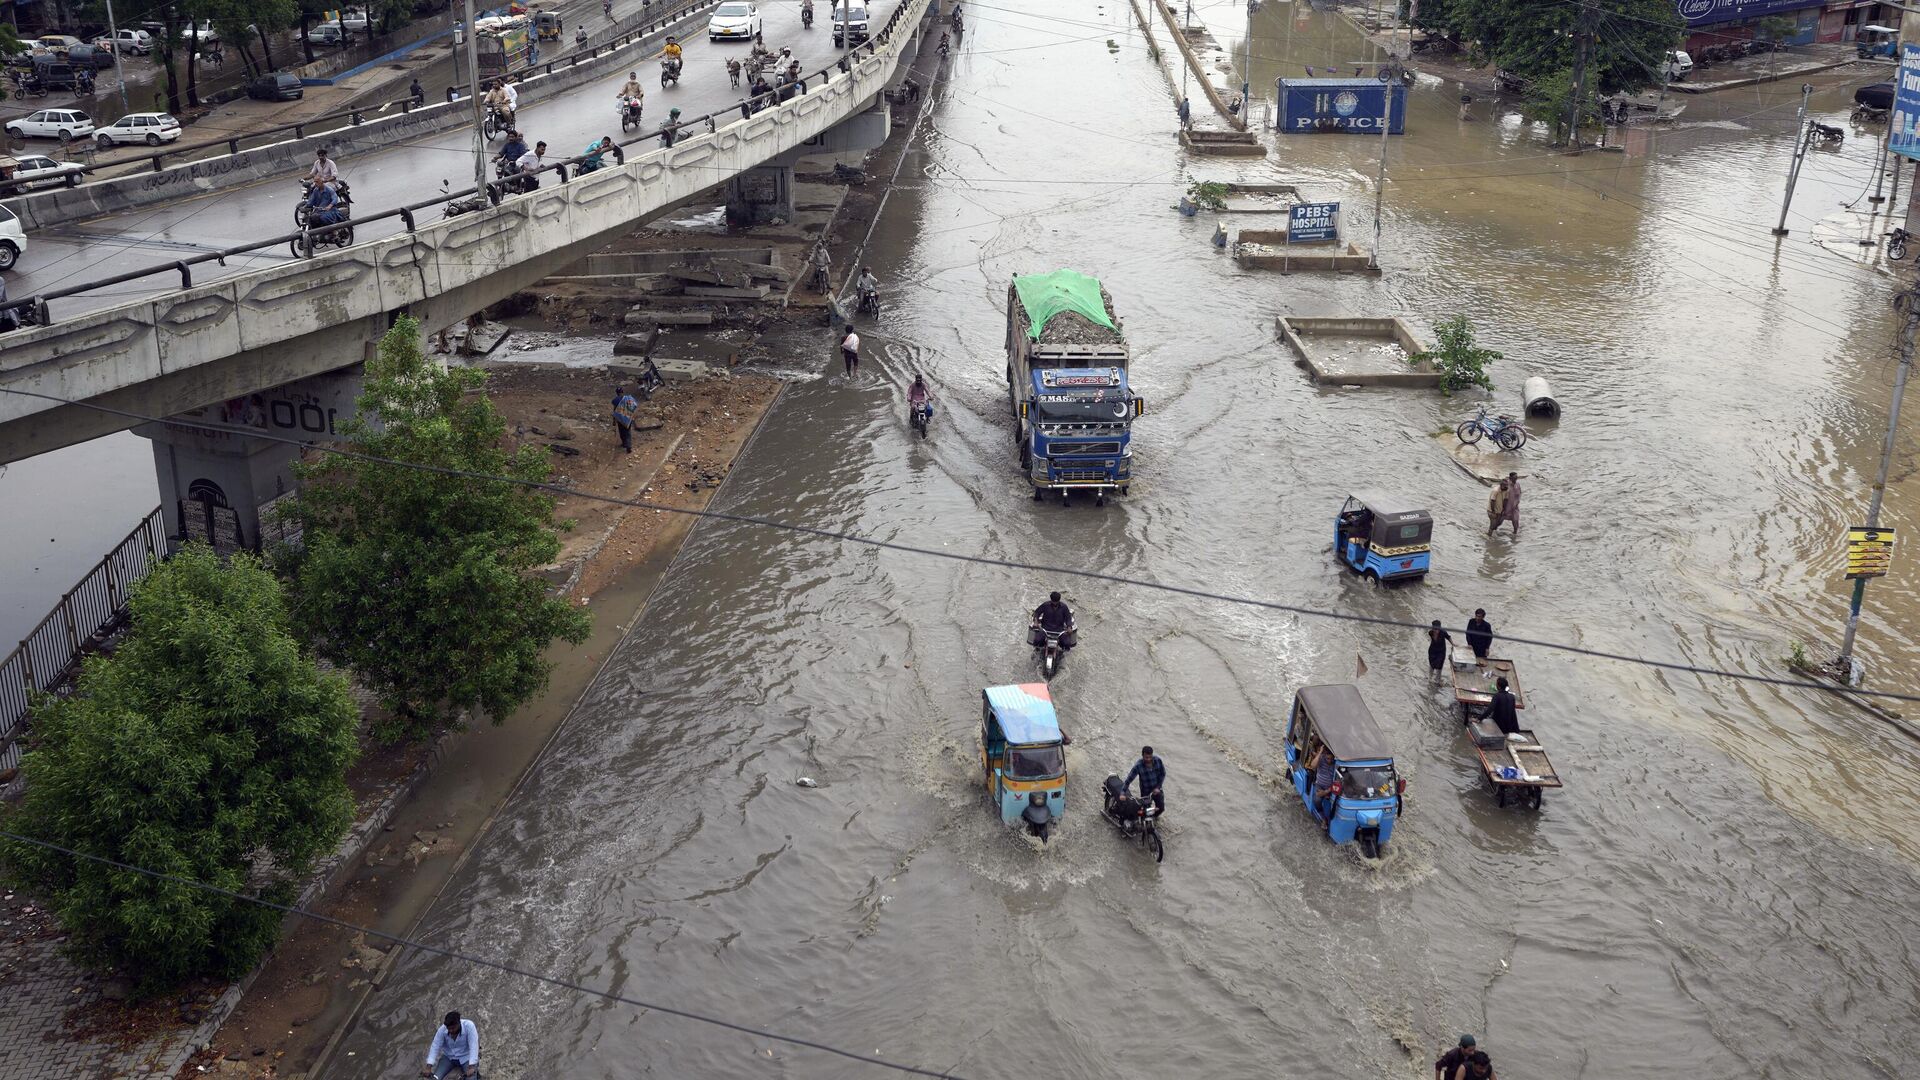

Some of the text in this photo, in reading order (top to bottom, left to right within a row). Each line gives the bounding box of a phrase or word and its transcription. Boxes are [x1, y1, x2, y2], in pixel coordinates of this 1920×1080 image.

[1296, 117, 1391, 128] POLICE
[1297, 206, 1331, 217] PEBS
[1292, 217, 1336, 228] HOSPITAL
